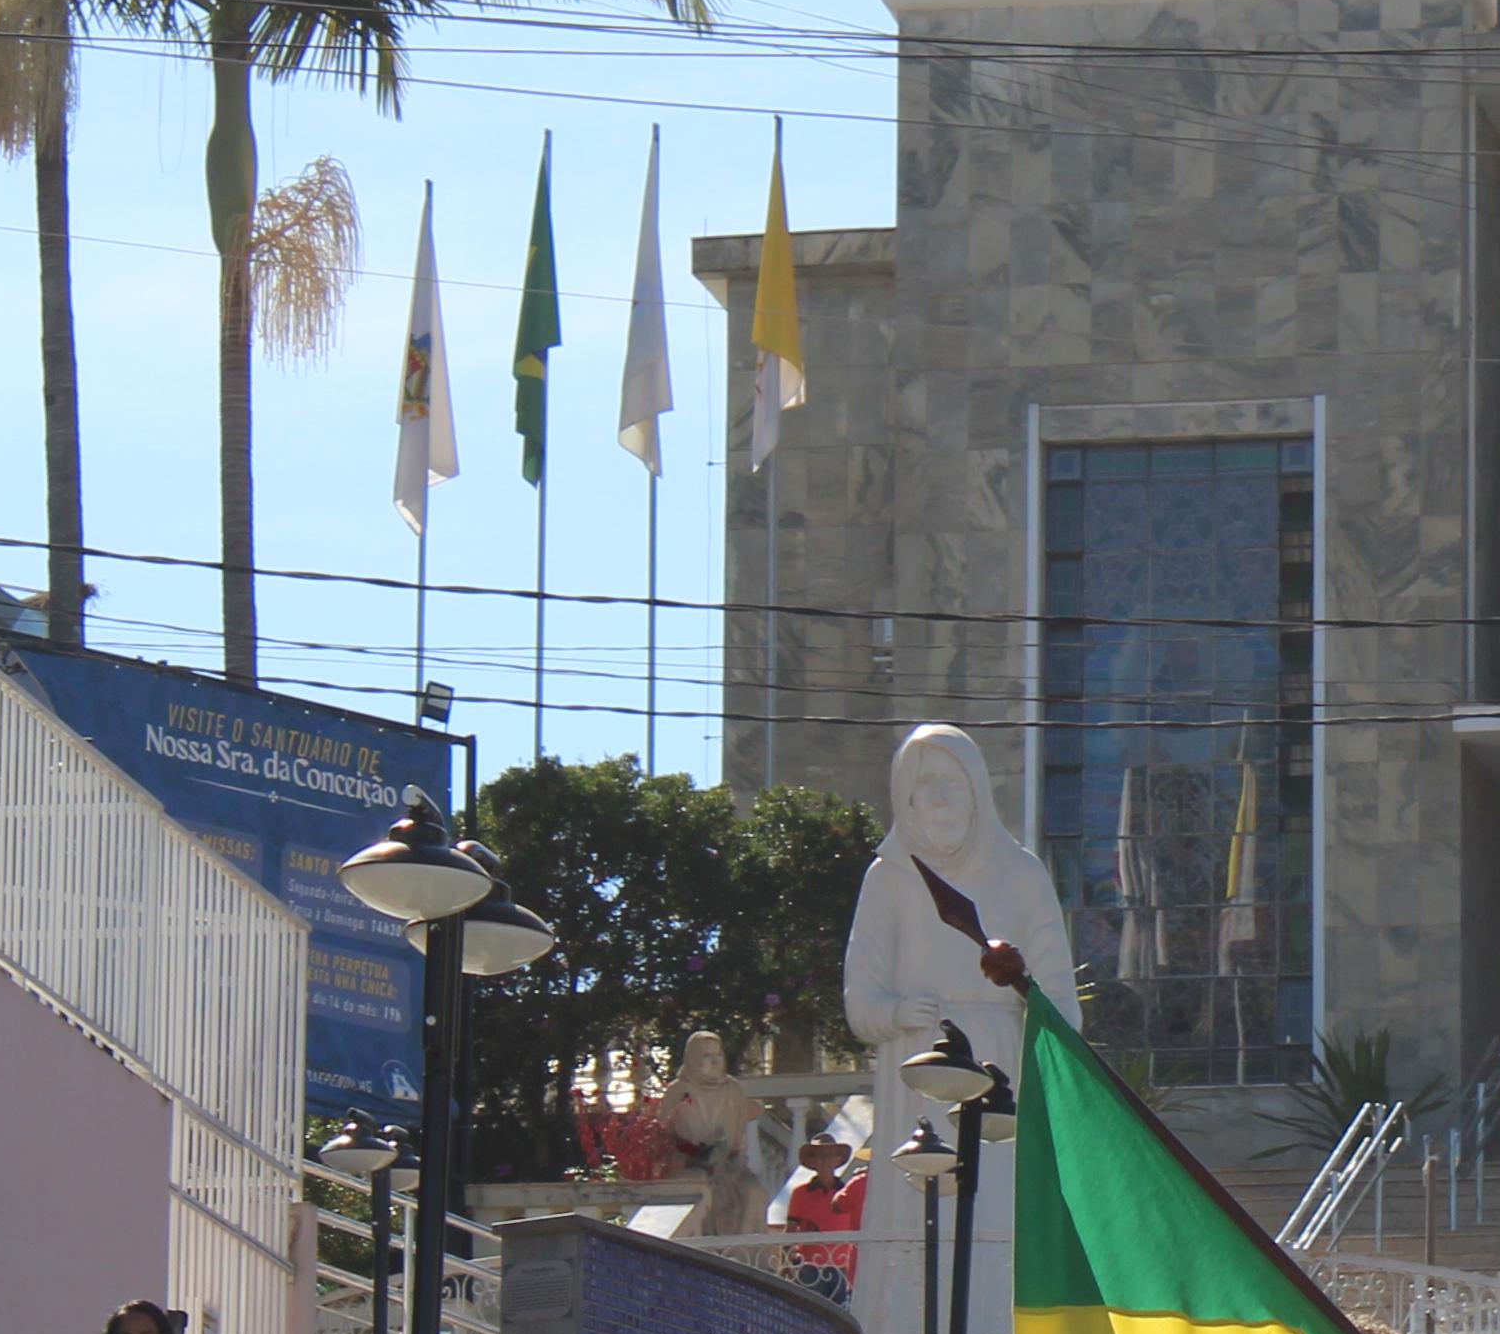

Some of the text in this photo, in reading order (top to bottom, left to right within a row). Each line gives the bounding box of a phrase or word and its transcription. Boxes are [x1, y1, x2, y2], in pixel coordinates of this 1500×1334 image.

[145, 723, 397, 808] Nossa Sra. da Conceição
[168, 703, 381, 774] VISITE O SANTUÁRIO DE
[289, 851, 329, 876] SANTO
